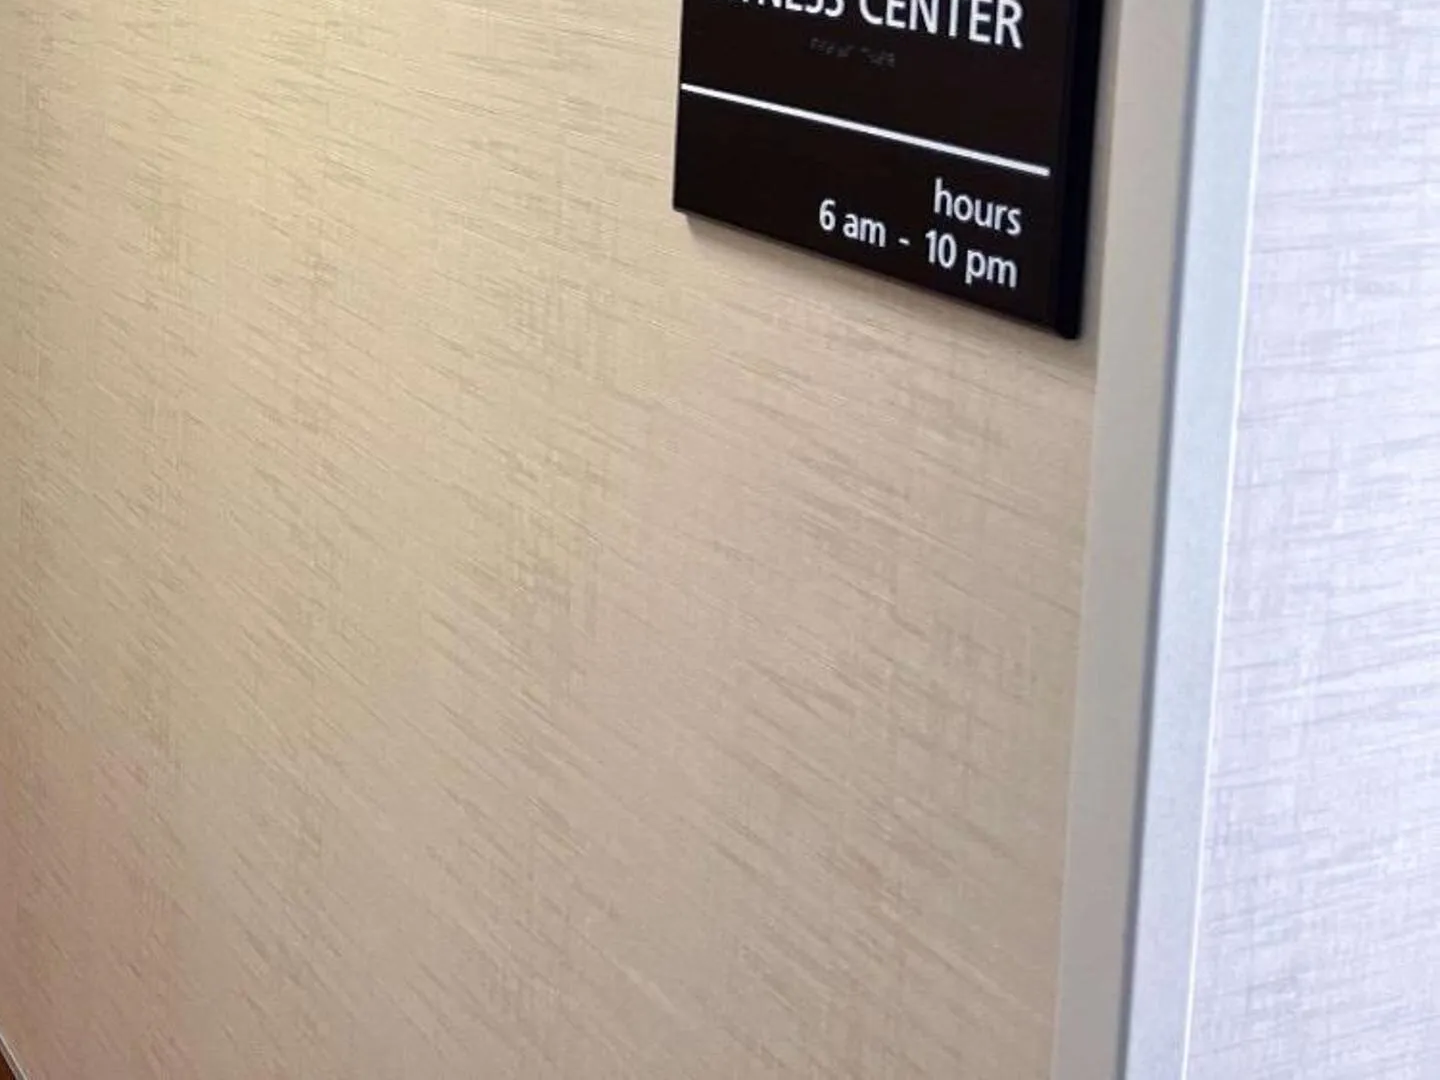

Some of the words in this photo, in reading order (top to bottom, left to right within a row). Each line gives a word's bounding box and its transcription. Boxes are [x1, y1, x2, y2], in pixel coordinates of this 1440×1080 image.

[819, 198, 836, 232] 6
[842, 213, 886, 248] am
[925, 229, 957, 269] 10
[965, 248, 1018, 288] pm
[933, 177, 1022, 236] hours
